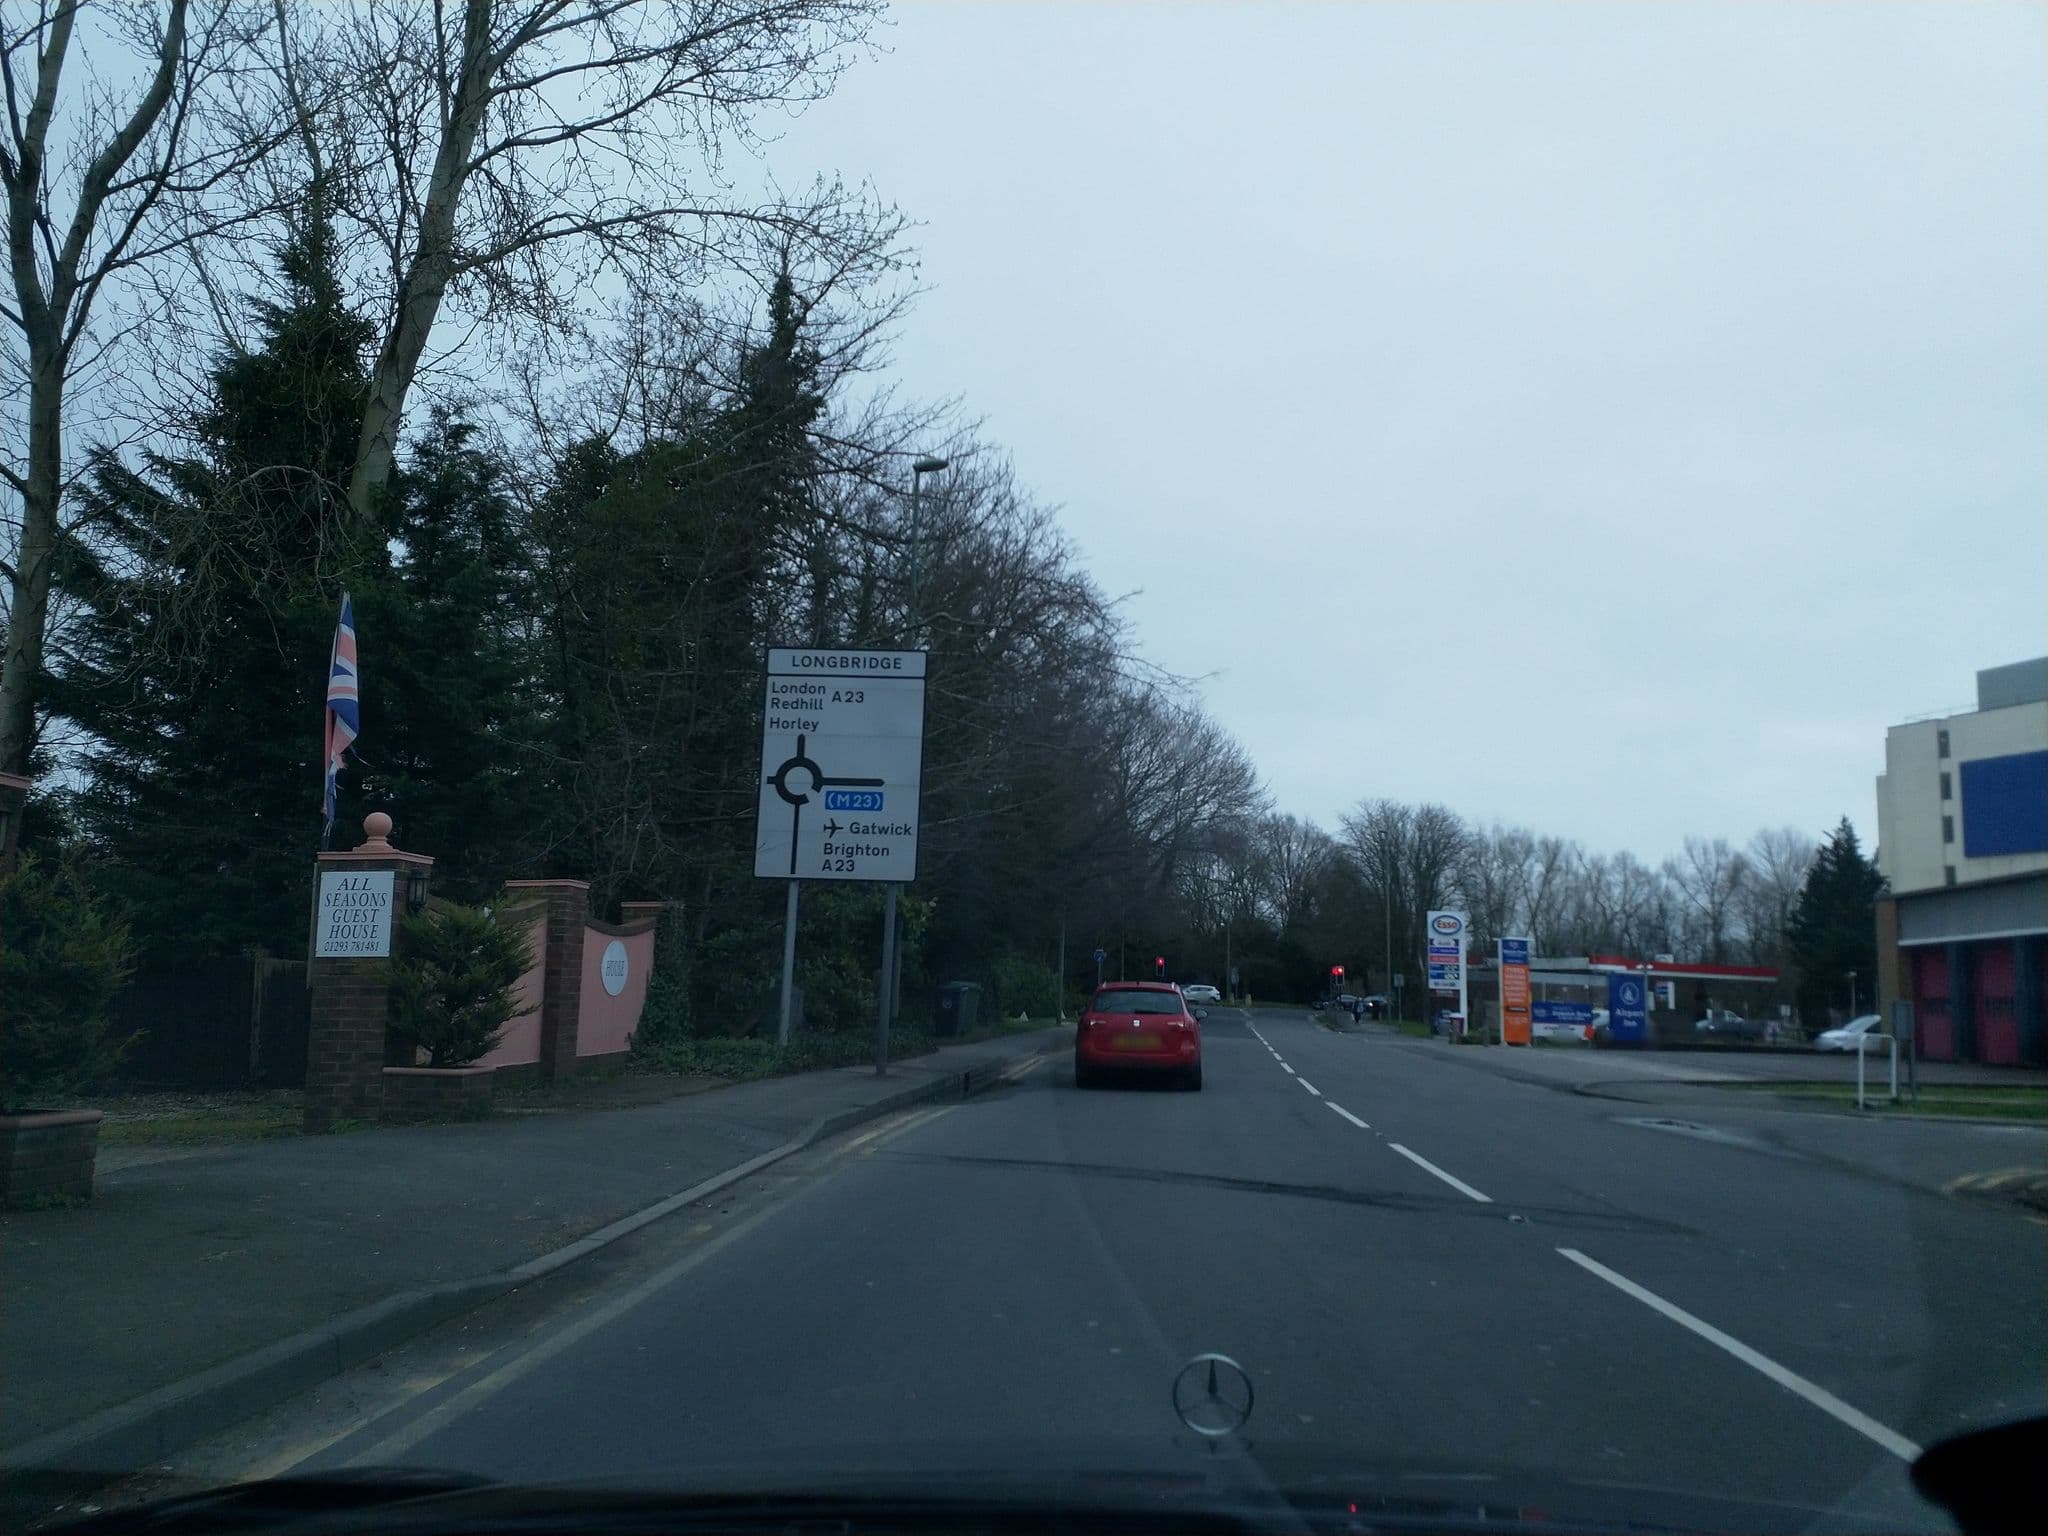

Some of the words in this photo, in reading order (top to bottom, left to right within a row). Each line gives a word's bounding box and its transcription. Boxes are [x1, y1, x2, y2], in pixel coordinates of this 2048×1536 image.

[791, 655, 903, 670] LONGBRIDGE
[771, 682, 826, 695] London
[831, 690, 865, 703] A23
[770, 697, 824, 710] Redhill
[769, 717, 820, 732] Horley
[849, 822, 913, 836] Gatwick
[823, 842, 890, 858] Brighton
[821, 859, 855, 872] A23
[337, 878, 372, 891] ALL
[324, 893, 387, 907] SEASONS
[332, 908, 380, 923] GUEST
[1436, 919, 1458, 929] Esso
[329, 924, 379, 939] HOUSE
[324, 941, 349, 952] 01293
